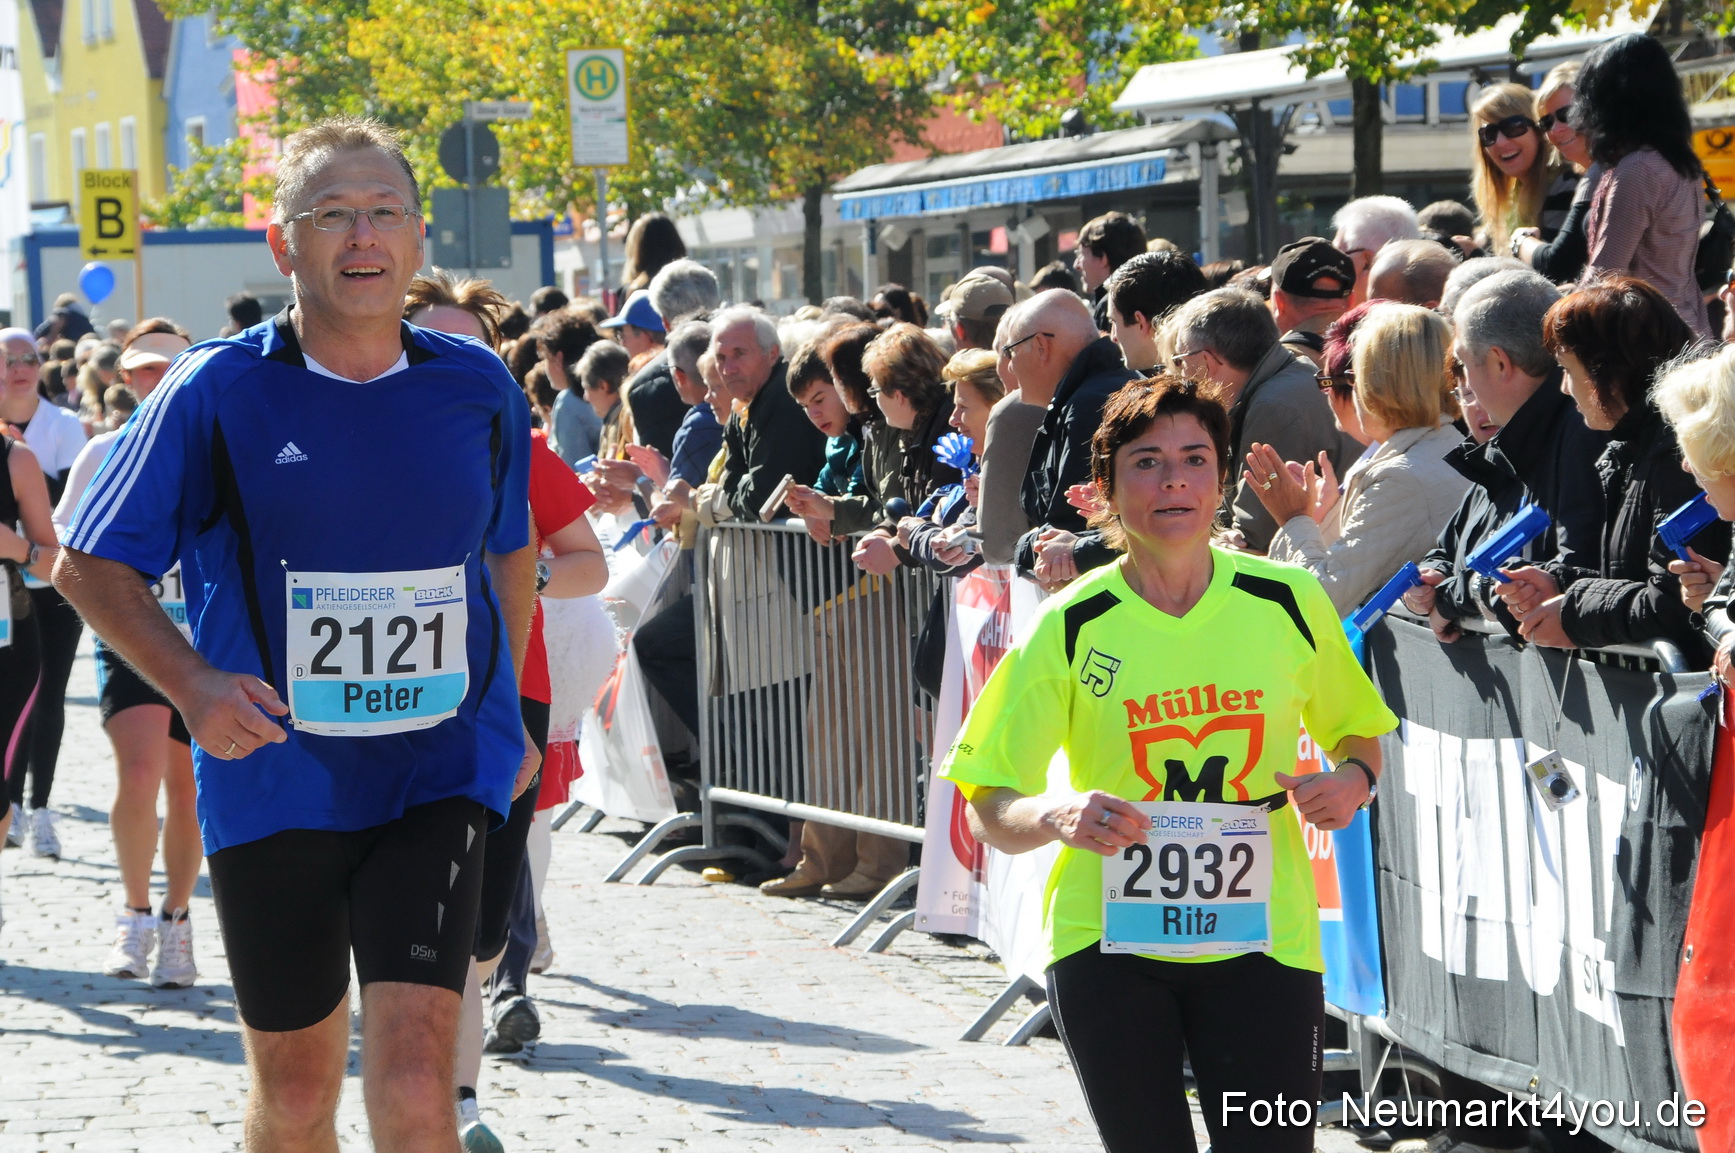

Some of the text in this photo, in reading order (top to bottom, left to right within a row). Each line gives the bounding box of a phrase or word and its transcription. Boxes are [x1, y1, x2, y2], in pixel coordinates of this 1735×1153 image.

[84, 171, 131, 189] Block
[94, 197, 125, 239] B
[275, 454, 308, 465] adidas
[315, 602, 396, 611] AKTIENGESELLSCHAFT
[316, 587, 396, 601] PFLEIDERER
[414, 586, 454, 601] BOCK
[310, 612, 444, 675] 2121
[344, 682, 424, 713] Peter
[1122, 683, 1264, 729] Müller
[1150, 815, 1204, 830] EIDERER
[1123, 842, 1255, 900] 2932
[1163, 906, 1218, 936] Rita
[1311, 1025, 1319, 1072] ICEPEAK
